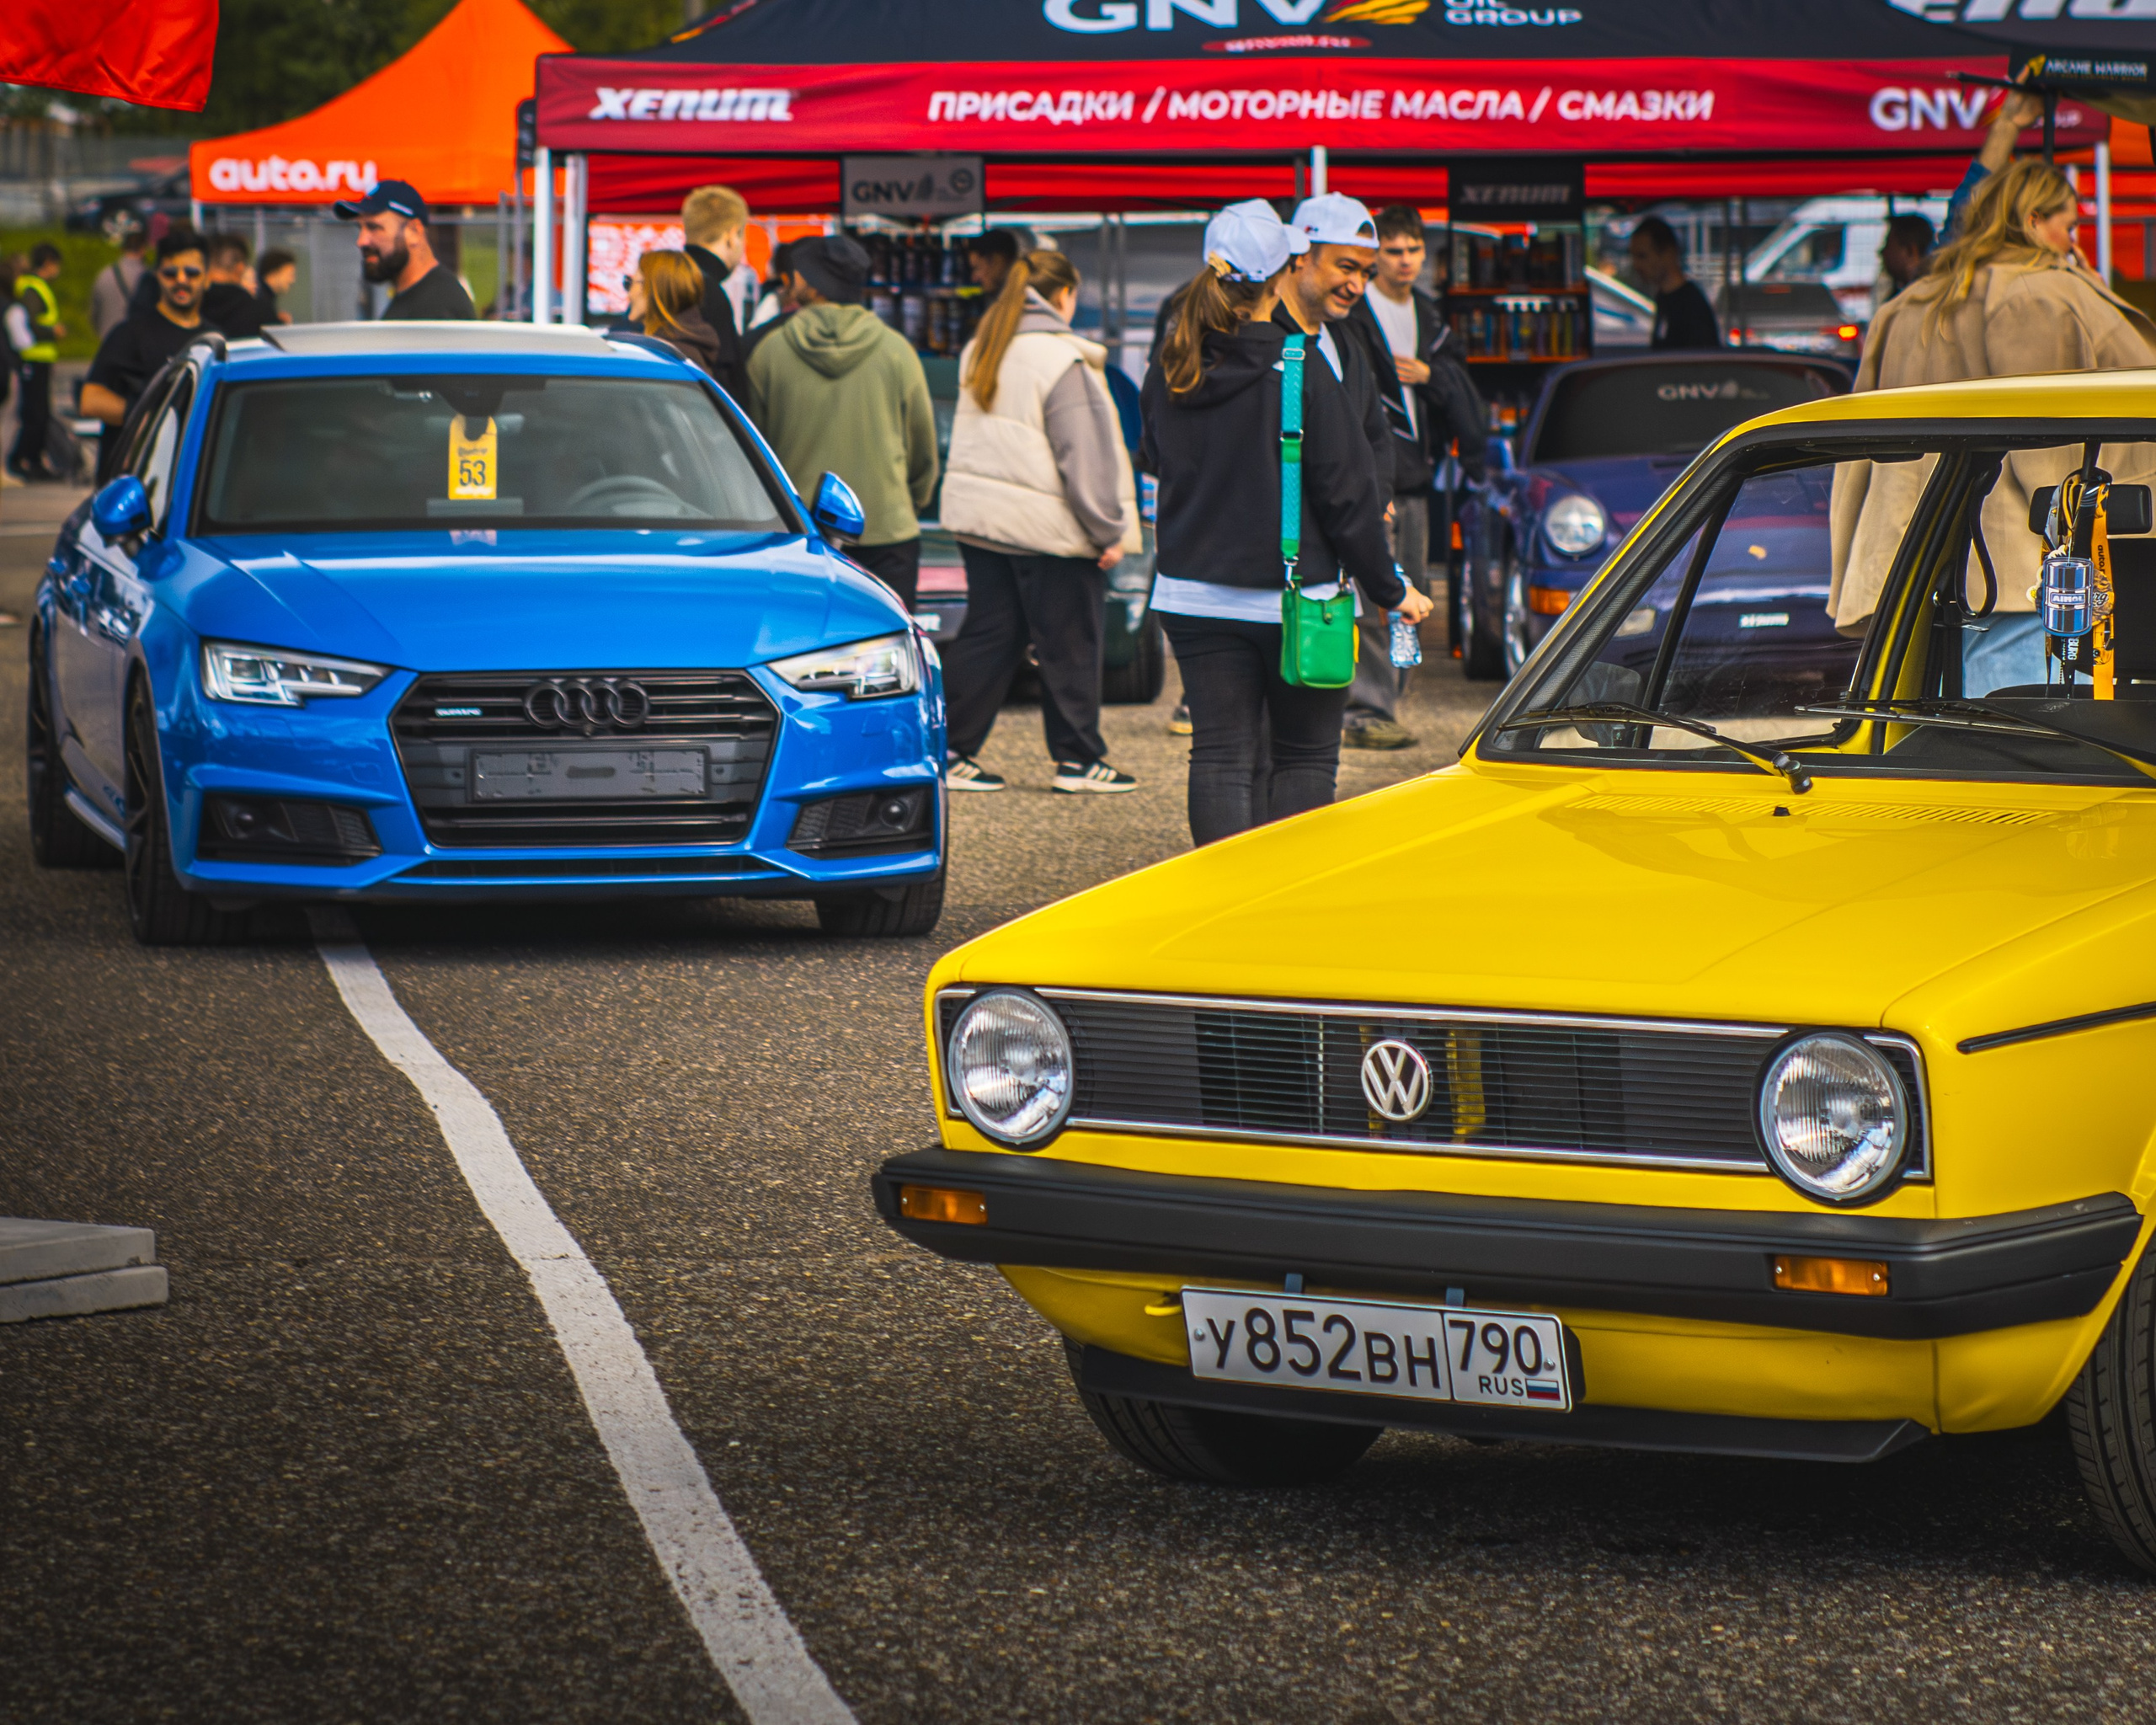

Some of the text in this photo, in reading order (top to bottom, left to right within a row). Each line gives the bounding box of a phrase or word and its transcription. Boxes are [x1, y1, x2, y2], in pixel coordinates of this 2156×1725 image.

[1445, 9, 1582, 26] GROUP
[927, 90, 1134, 126] ПРИСАДКИ
[1166, 89, 1385, 120] МОТОРНЫЕ
[1390, 89, 1524, 120] МАСЛА
[1557, 89, 1715, 121] СМАЗКИ
[1869, 86, 1988, 131] GNV
[851, 179, 914, 203] GNV
[459, 460, 486, 486] 53
[1449, 1320, 1542, 1376] 790
[1479, 1375, 1524, 1397] RUS
